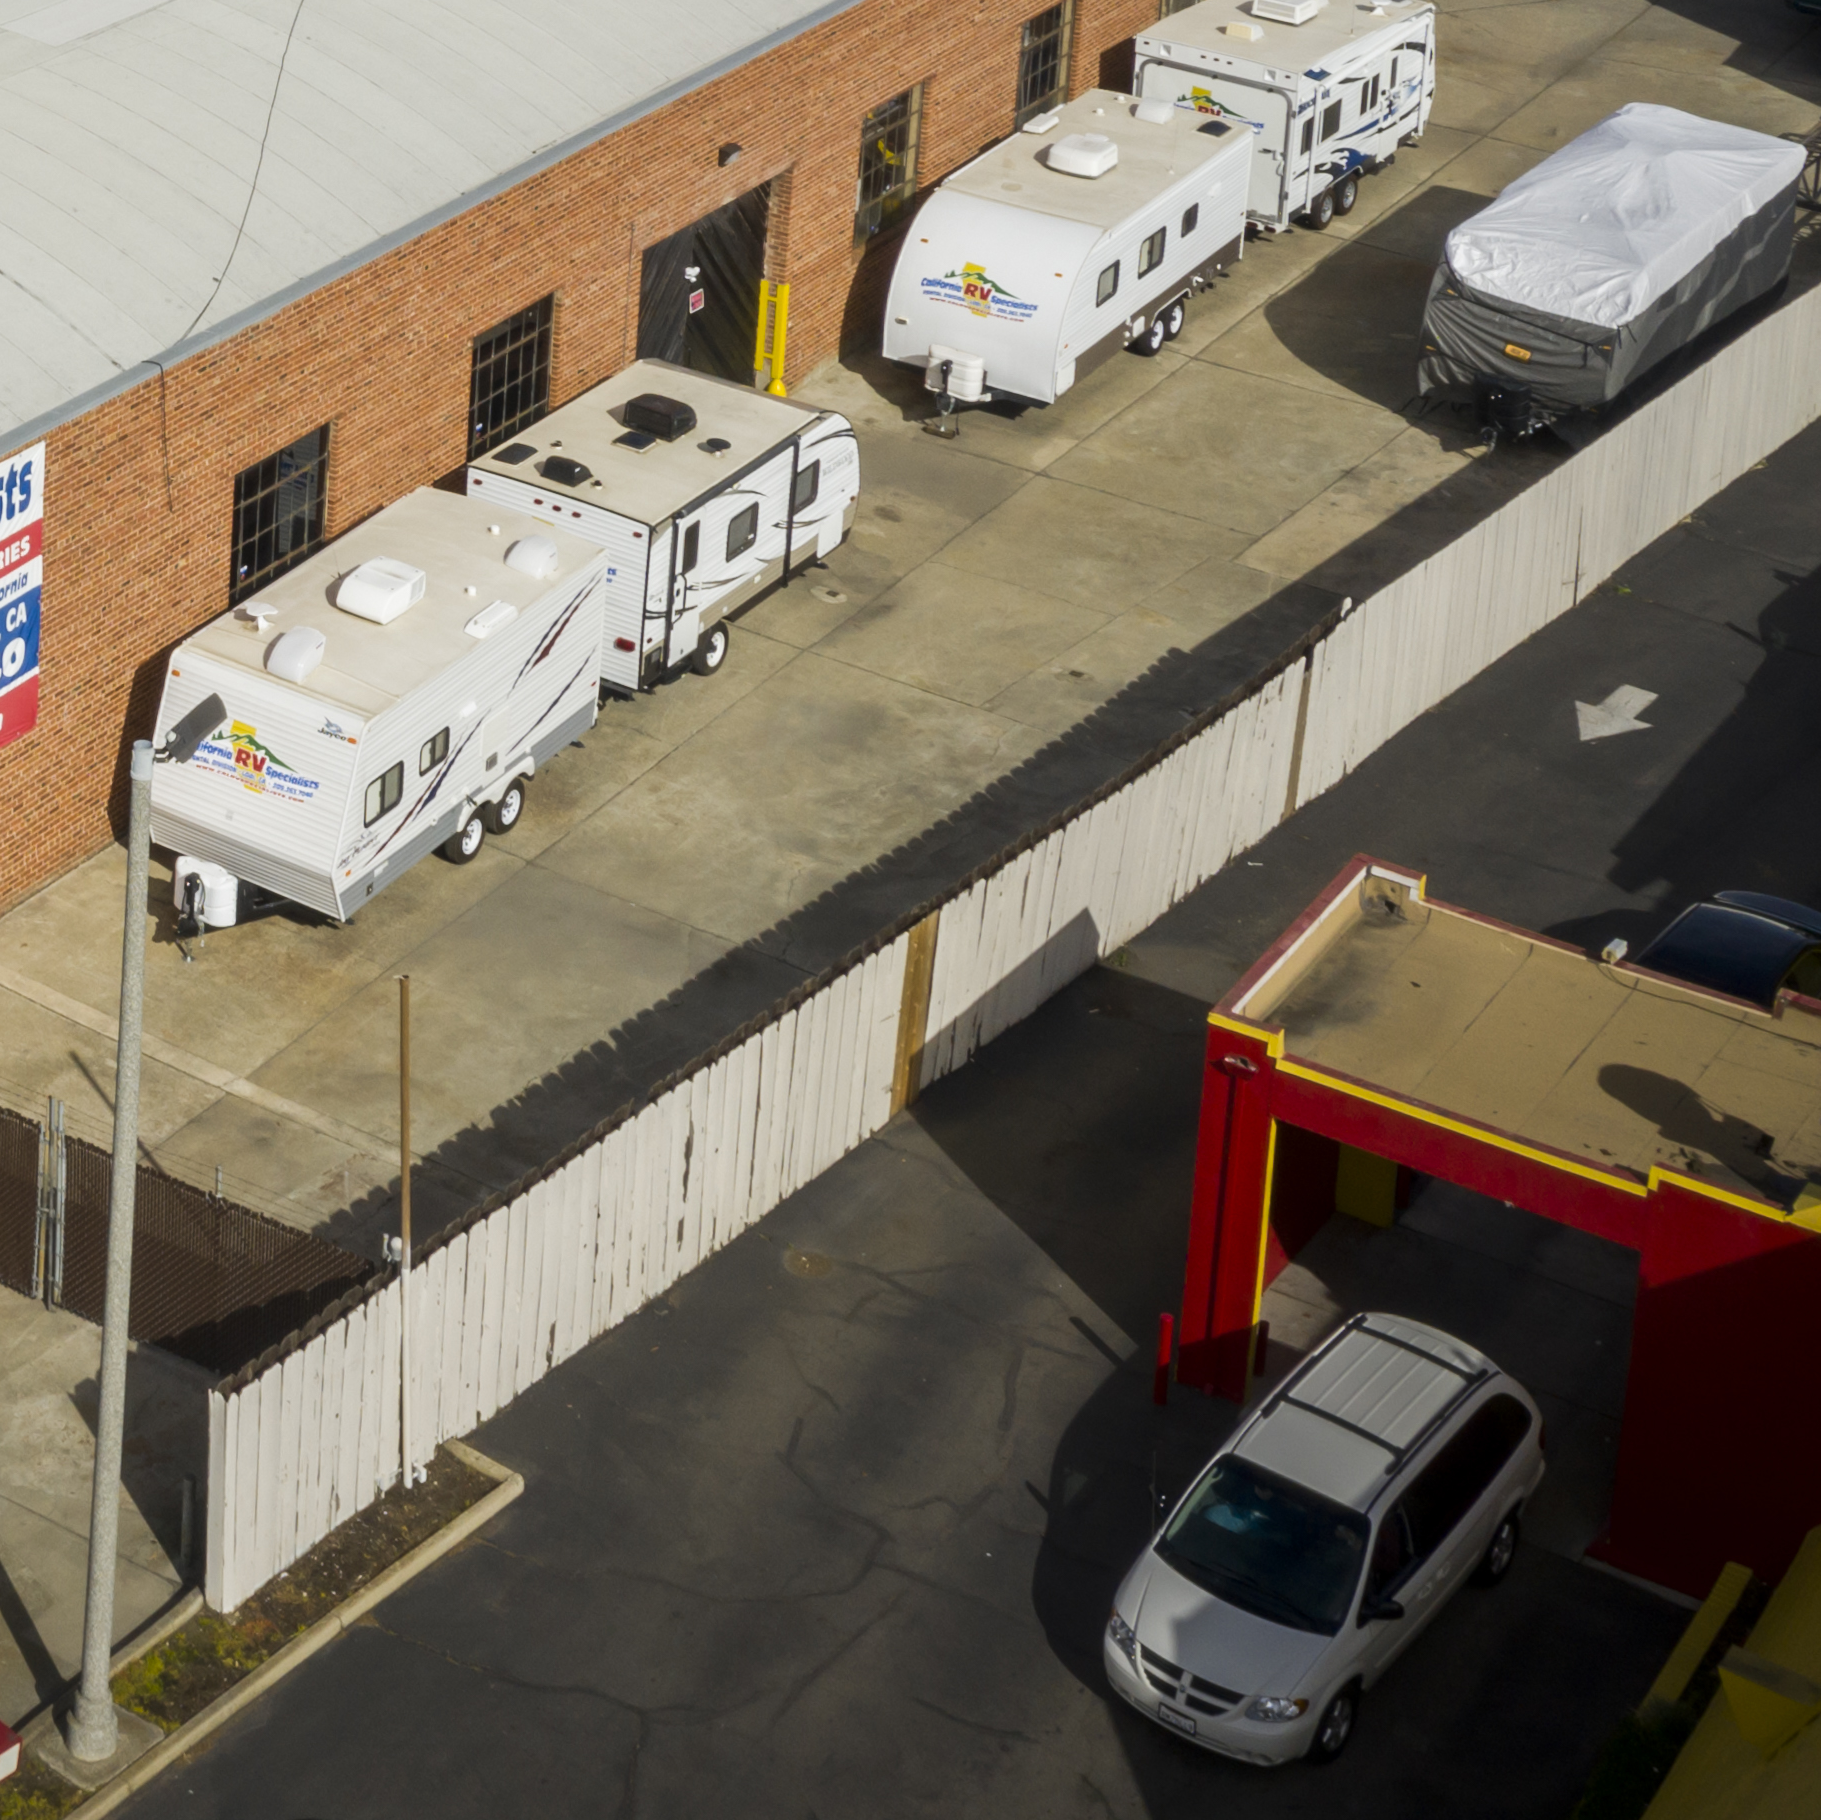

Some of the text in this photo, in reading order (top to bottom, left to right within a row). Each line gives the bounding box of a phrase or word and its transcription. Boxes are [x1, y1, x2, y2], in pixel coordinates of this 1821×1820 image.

[964, 282, 992, 301] RV
[5, 601, 28, 632] CA
[317, 727, 347, 742] Jayco
[234, 747, 267, 772] RV
[264, 765, 320, 790] Specialists
